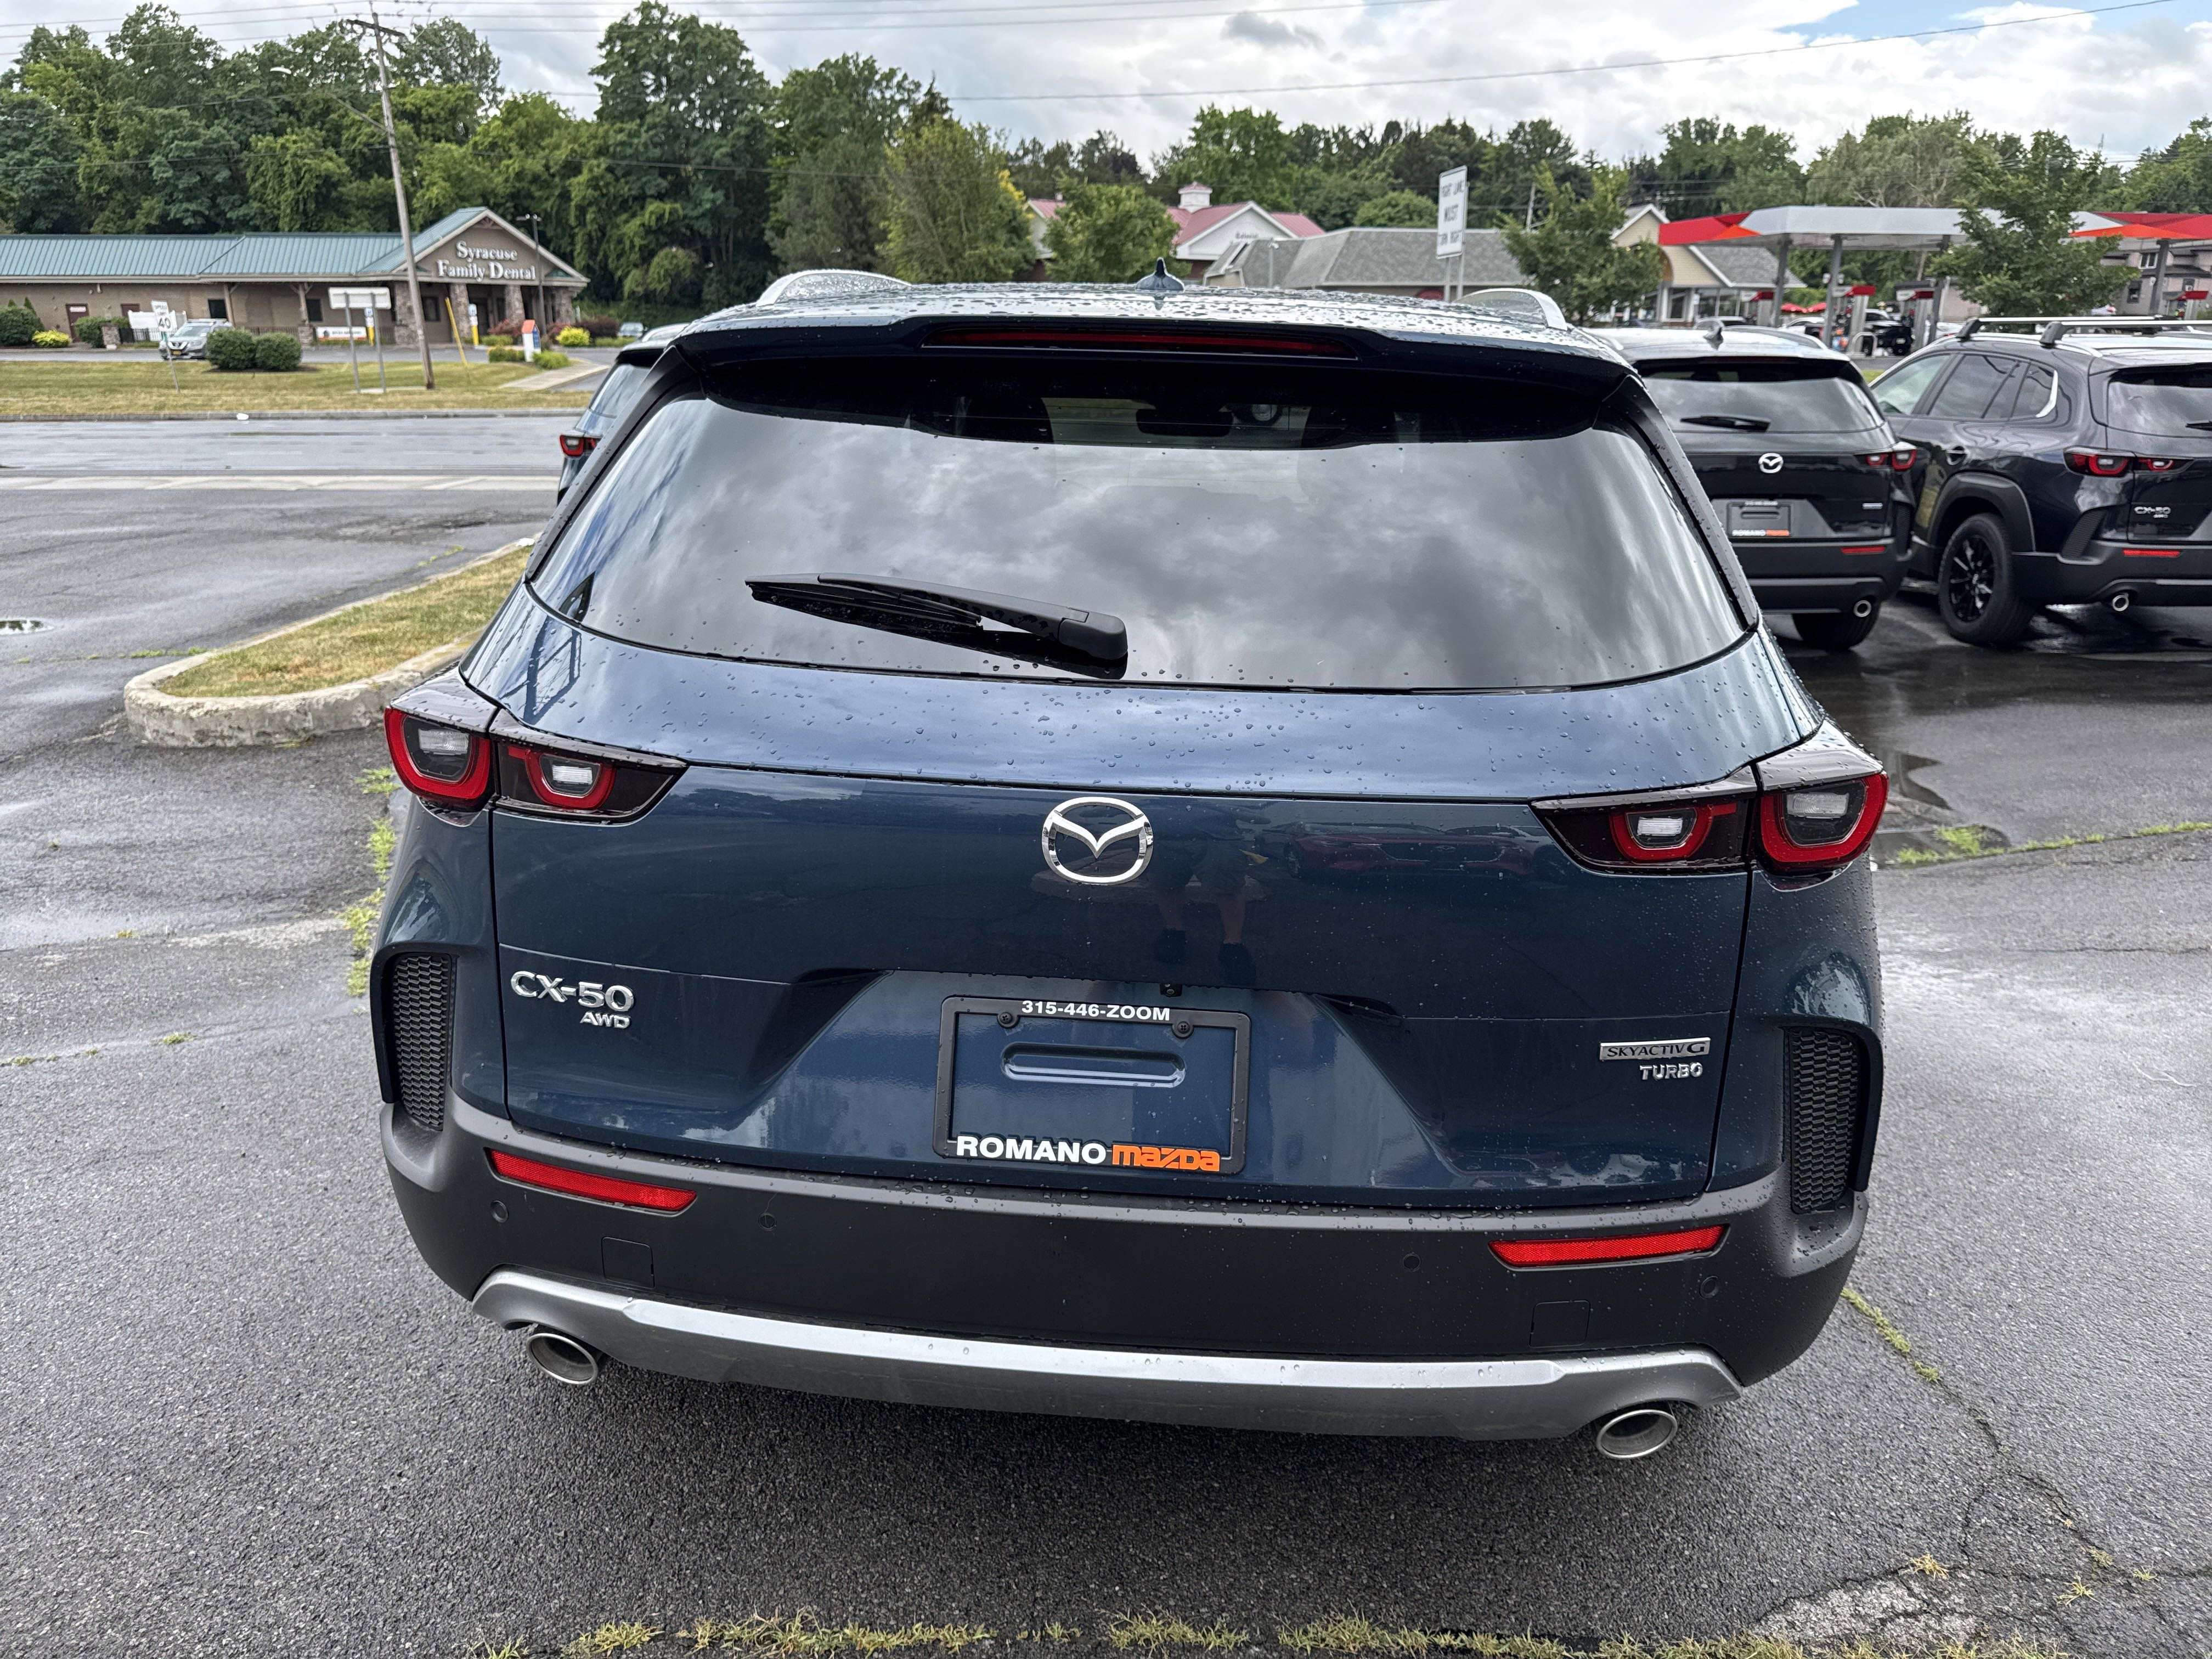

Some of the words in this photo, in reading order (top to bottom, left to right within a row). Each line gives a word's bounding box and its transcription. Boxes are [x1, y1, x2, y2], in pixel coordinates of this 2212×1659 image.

[456, 240, 518, 262] Syracuse
[437, 259, 485, 282] Family
[489, 261, 536, 280] Dental
[159, 317, 171, 329] 40
[511, 970, 634, 1012] CX-50
[579, 1011, 630, 1029] AWD
[1022, 1000, 1170, 1021] 315-446-ZOOM
[1639, 1062, 1703, 1080] TURBO
[957, 1135, 1106, 1164] ROMANO
